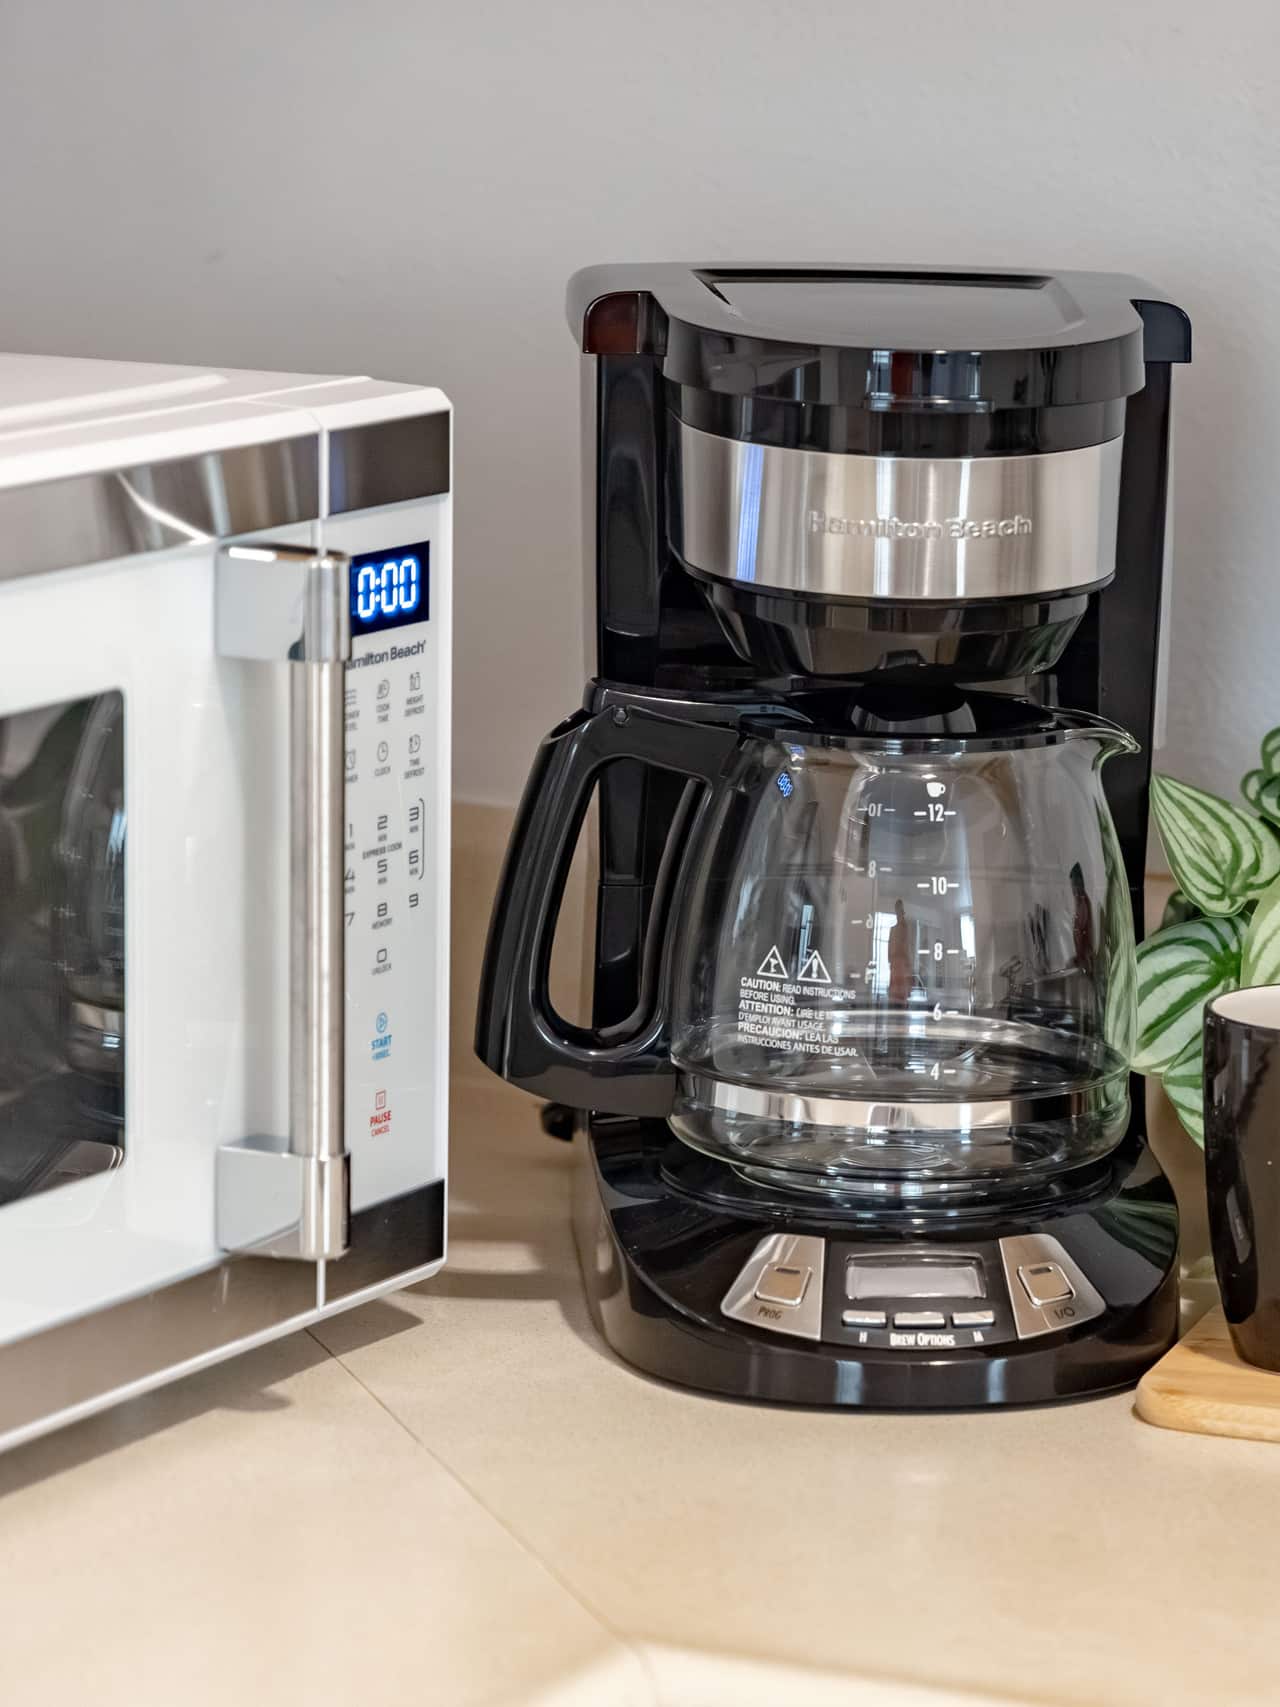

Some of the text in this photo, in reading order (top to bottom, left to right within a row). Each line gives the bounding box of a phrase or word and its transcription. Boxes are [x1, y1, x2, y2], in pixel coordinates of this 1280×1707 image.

[946, 514, 1033, 540] Beach
[357, 558, 417, 618] 0:00
[345, 640, 424, 670] amilton Beach
[409, 806, 419, 822] 3
[928, 803, 945, 823] 12
[377, 815, 388, 831] 2
[377, 858, 388, 874] 5
[408, 849, 419, 865] 6
[931, 876, 948, 895] 10
[408, 893, 419, 908] 9
[377, 902, 388, 918] 8
[345, 912, 355, 927] 7
[934, 942, 944, 961] 8
[740, 976, 857, 1000] CAUTION: READ INSTRUCTIONS
[740, 988, 769, 1002] BEFORE
[739, 999, 794, 1017] ATTENTION:
[815, 1010, 825, 1020] LE
[932, 1001, 943, 1021] 6
[792, 1042, 820, 1054] ANTES
[930, 1062, 940, 1081] 4
[370, 1109, 391, 1127] PAUSE
[859, 1331, 868, 1344] H
